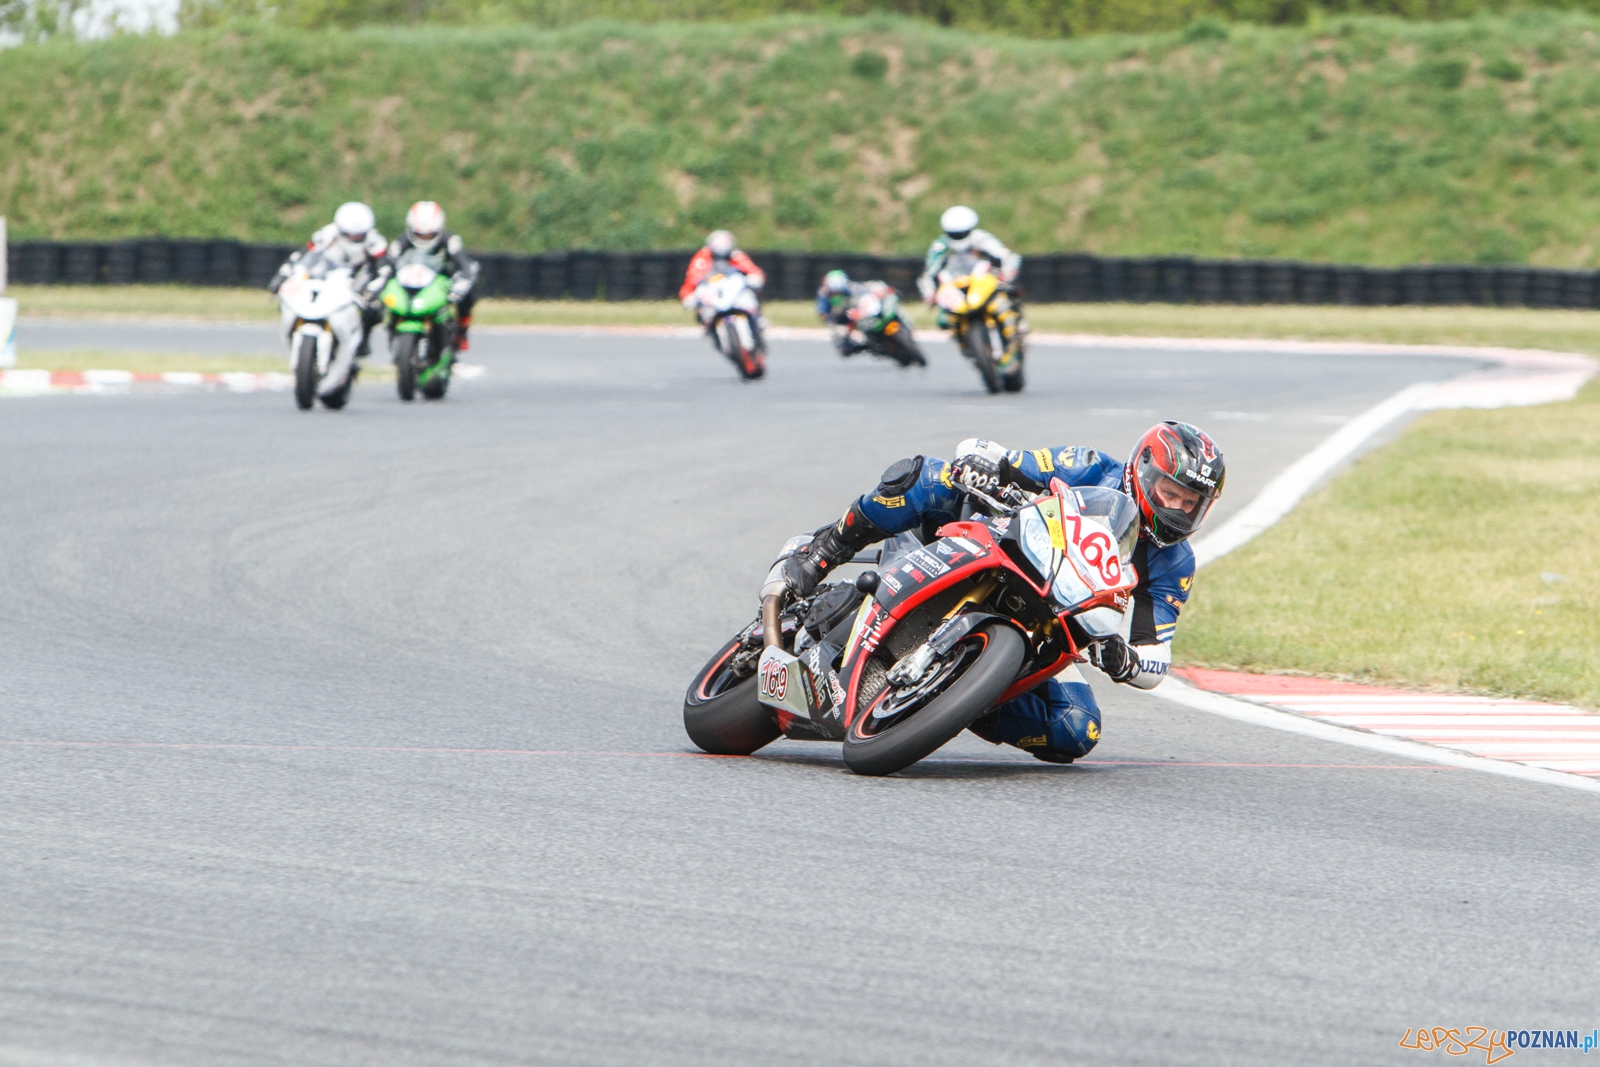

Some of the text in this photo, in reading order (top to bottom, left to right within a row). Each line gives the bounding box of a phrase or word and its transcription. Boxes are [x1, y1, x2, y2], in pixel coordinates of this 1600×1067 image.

[1185, 469, 1217, 488] SHARK
[1066, 515, 1121, 587] 169
[761, 657, 789, 700] 169
[809, 645, 826, 706] aprilia
